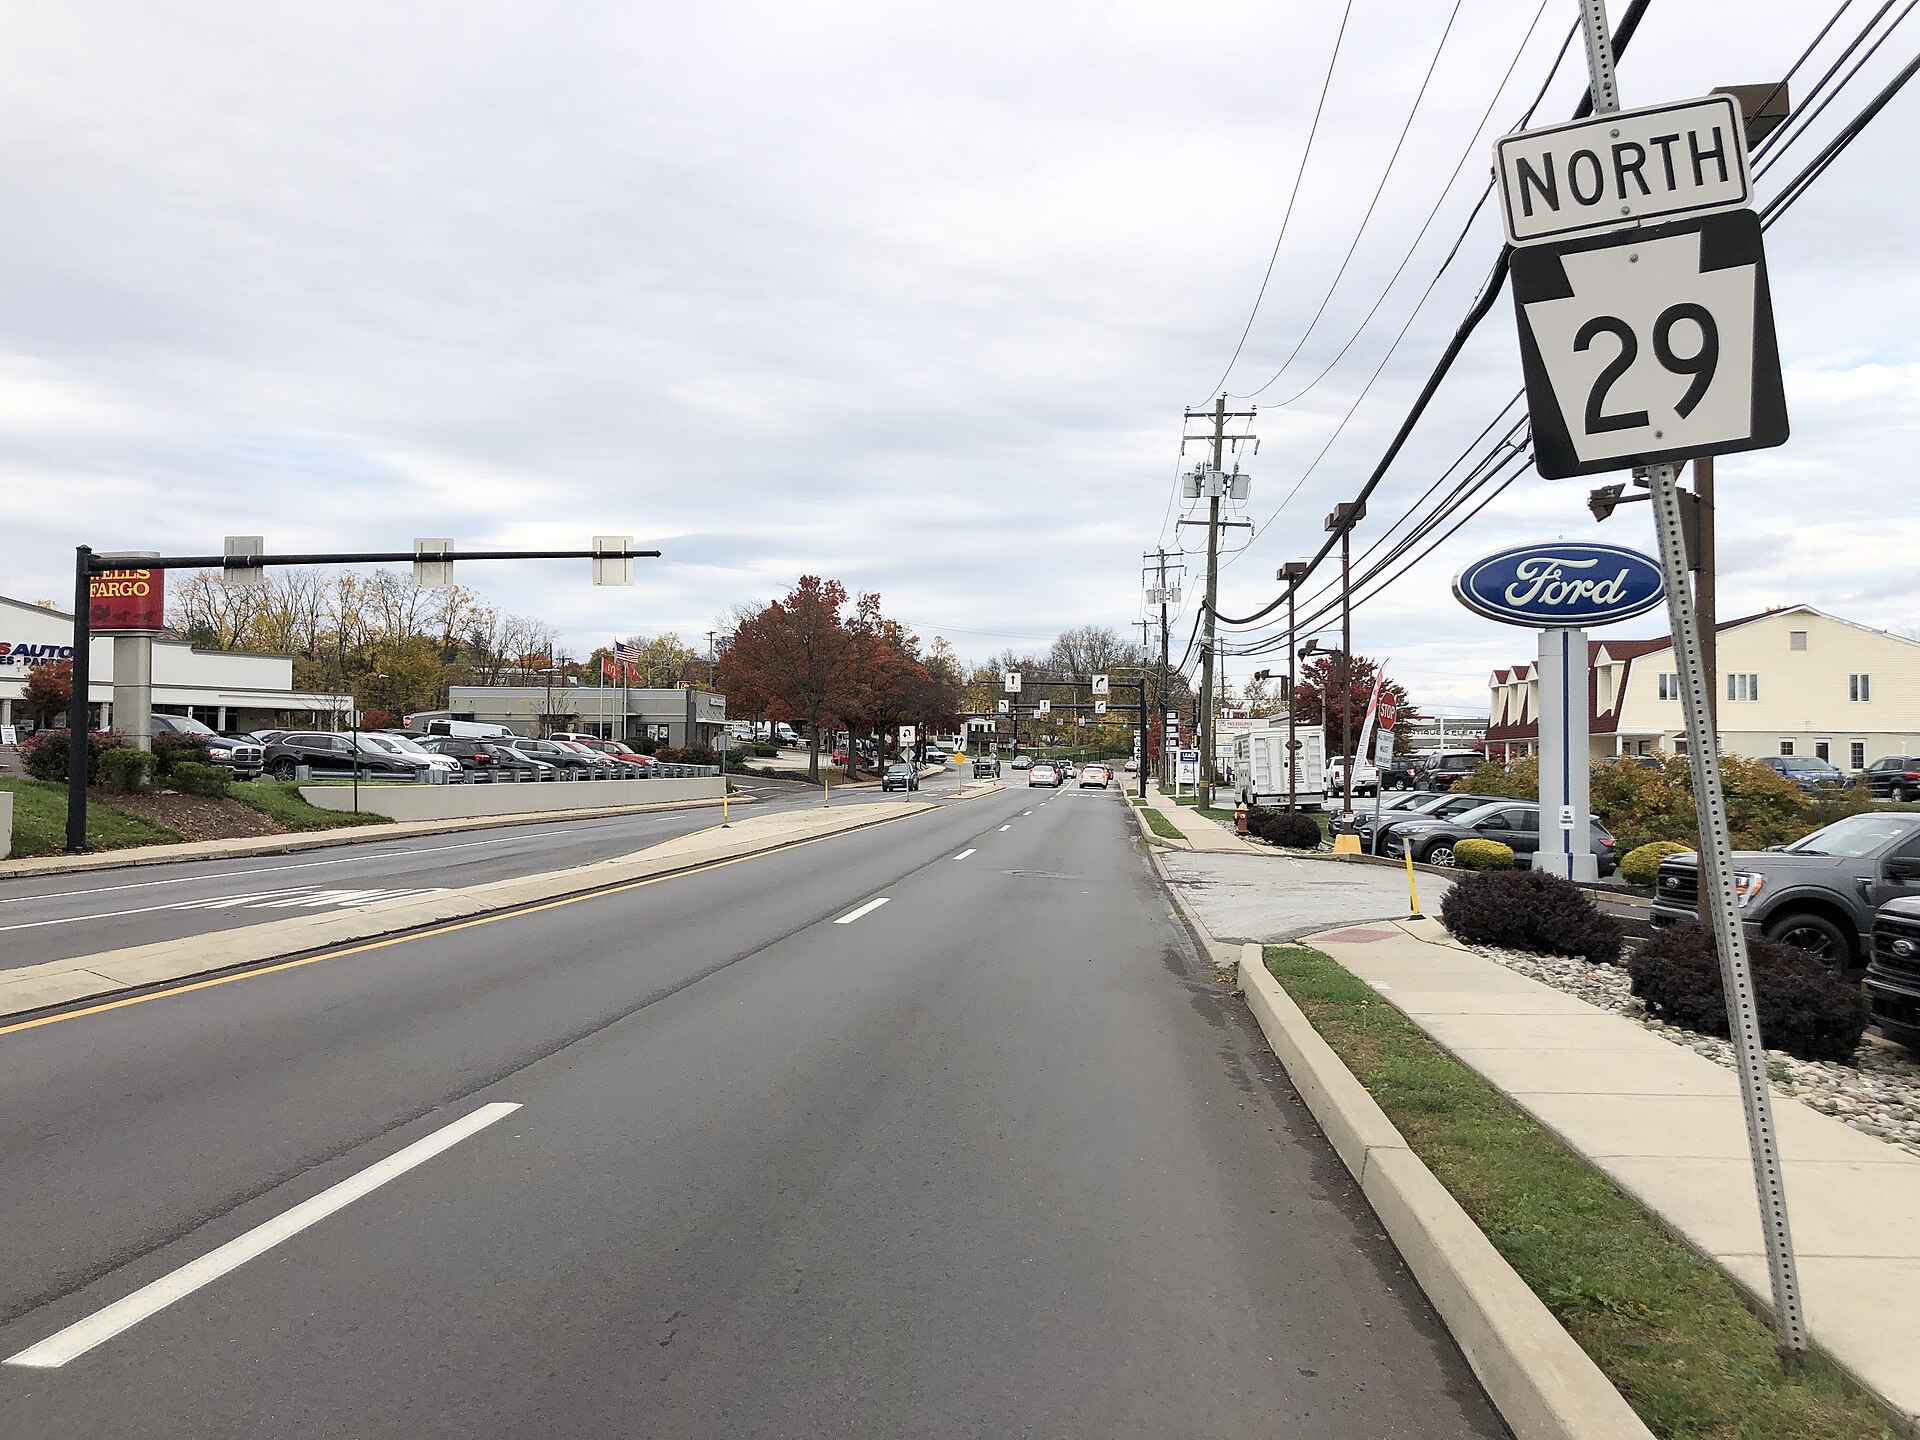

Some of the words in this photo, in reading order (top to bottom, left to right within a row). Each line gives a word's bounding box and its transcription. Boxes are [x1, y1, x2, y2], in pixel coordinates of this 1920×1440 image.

[1515, 126, 1729, 217] NORTH
[1573, 302, 1719, 435] 29
[90, 582, 149, 597] FARGO
[1504, 557, 1630, 607] Ford
[11, 644, 74, 658] AUTO
[1380, 703, 1395, 719] STOP
